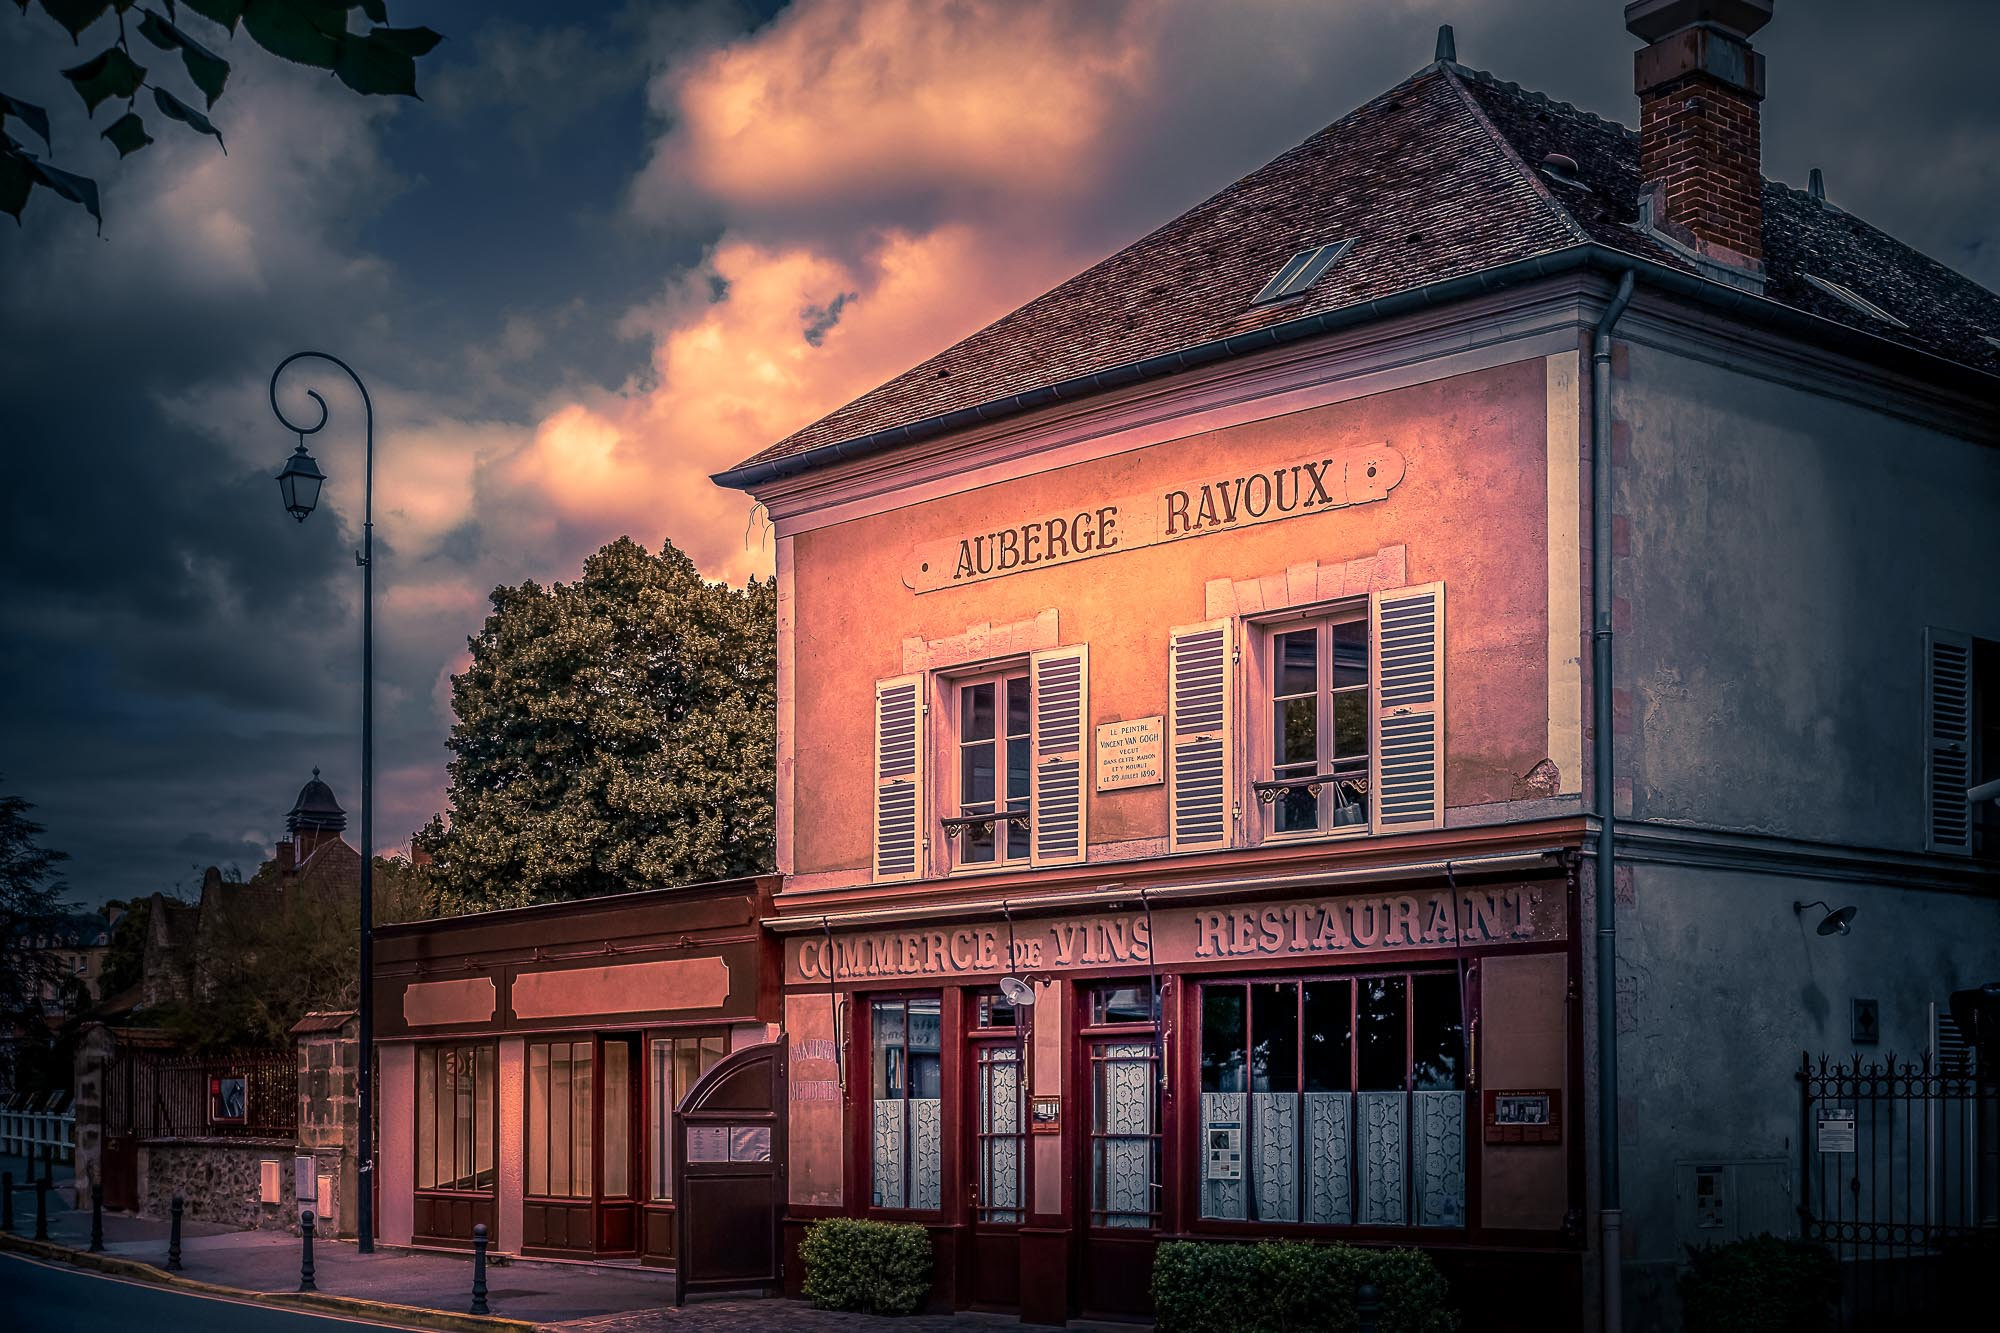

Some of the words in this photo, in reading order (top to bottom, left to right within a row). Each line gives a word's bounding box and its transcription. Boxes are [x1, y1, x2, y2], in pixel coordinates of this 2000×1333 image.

[952, 505, 1119, 580] AUBERGE
[1164, 459, 1333, 535] RAVOUX
[1100, 740, 1123, 748] VINCENT
[1126, 736, 1137, 746] VAN
[1140, 734, 1159, 744] GOGH
[1122, 724, 1148, 734] PEINTRE
[1140, 770, 1156, 778] 1890
[1194, 888, 1542, 958] RESTAURANT
[799, 926, 1000, 980] COMMERCE
[1005, 938, 1044, 970] DE
[1050, 917, 1153, 967] VINS
